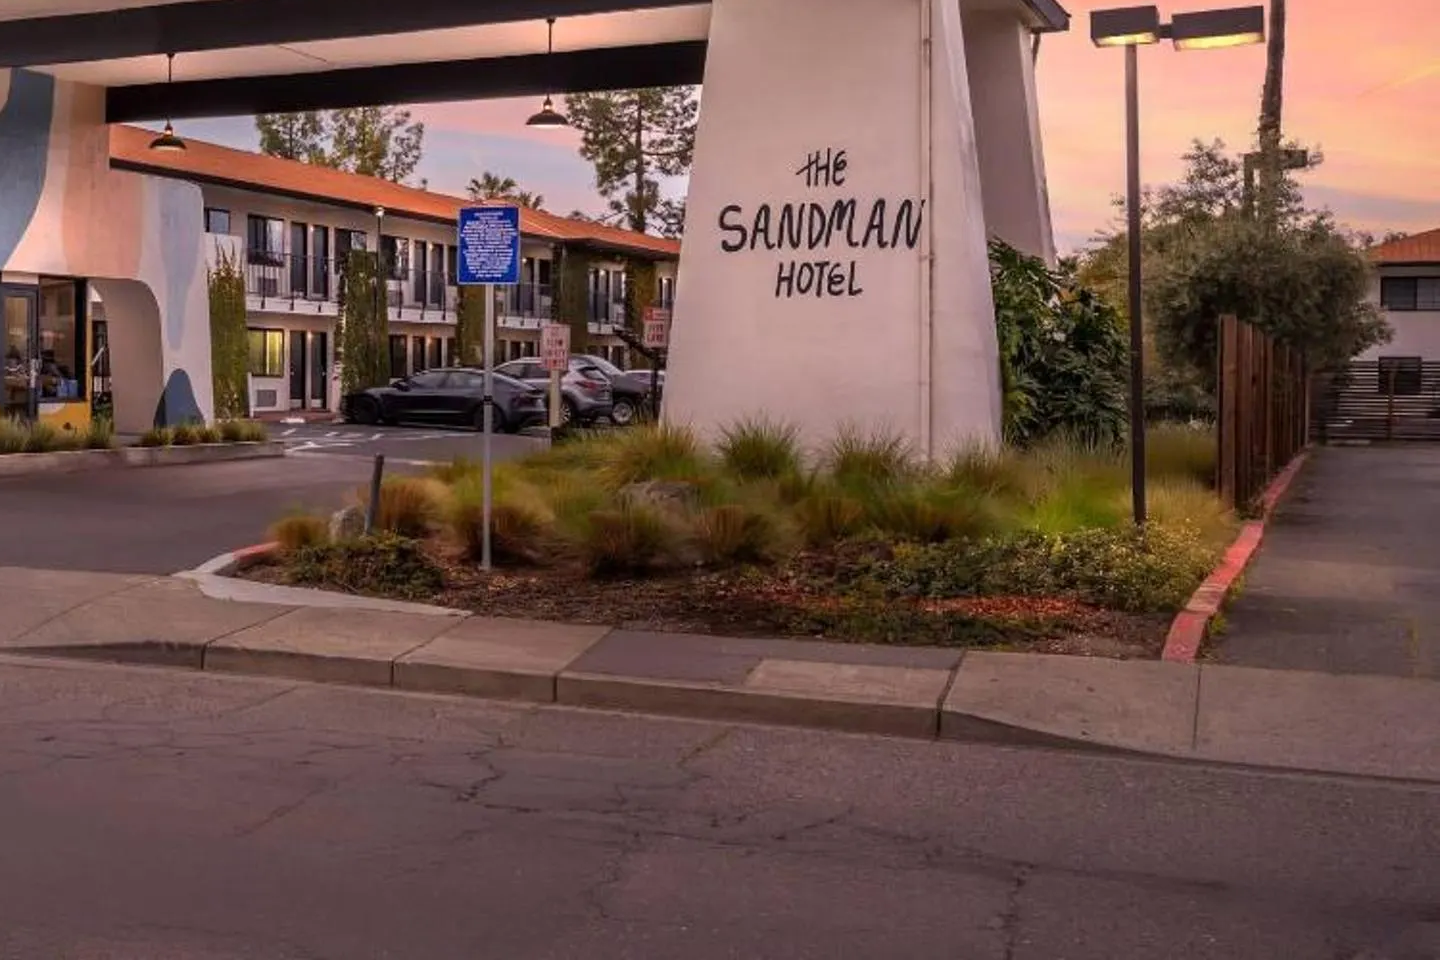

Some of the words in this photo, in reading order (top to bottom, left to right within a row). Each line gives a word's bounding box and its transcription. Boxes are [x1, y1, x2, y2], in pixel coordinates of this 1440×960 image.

[796, 147, 848, 188] THE
[718, 197, 927, 253] SANDMAN
[775, 260, 863, 299] HOTEL
